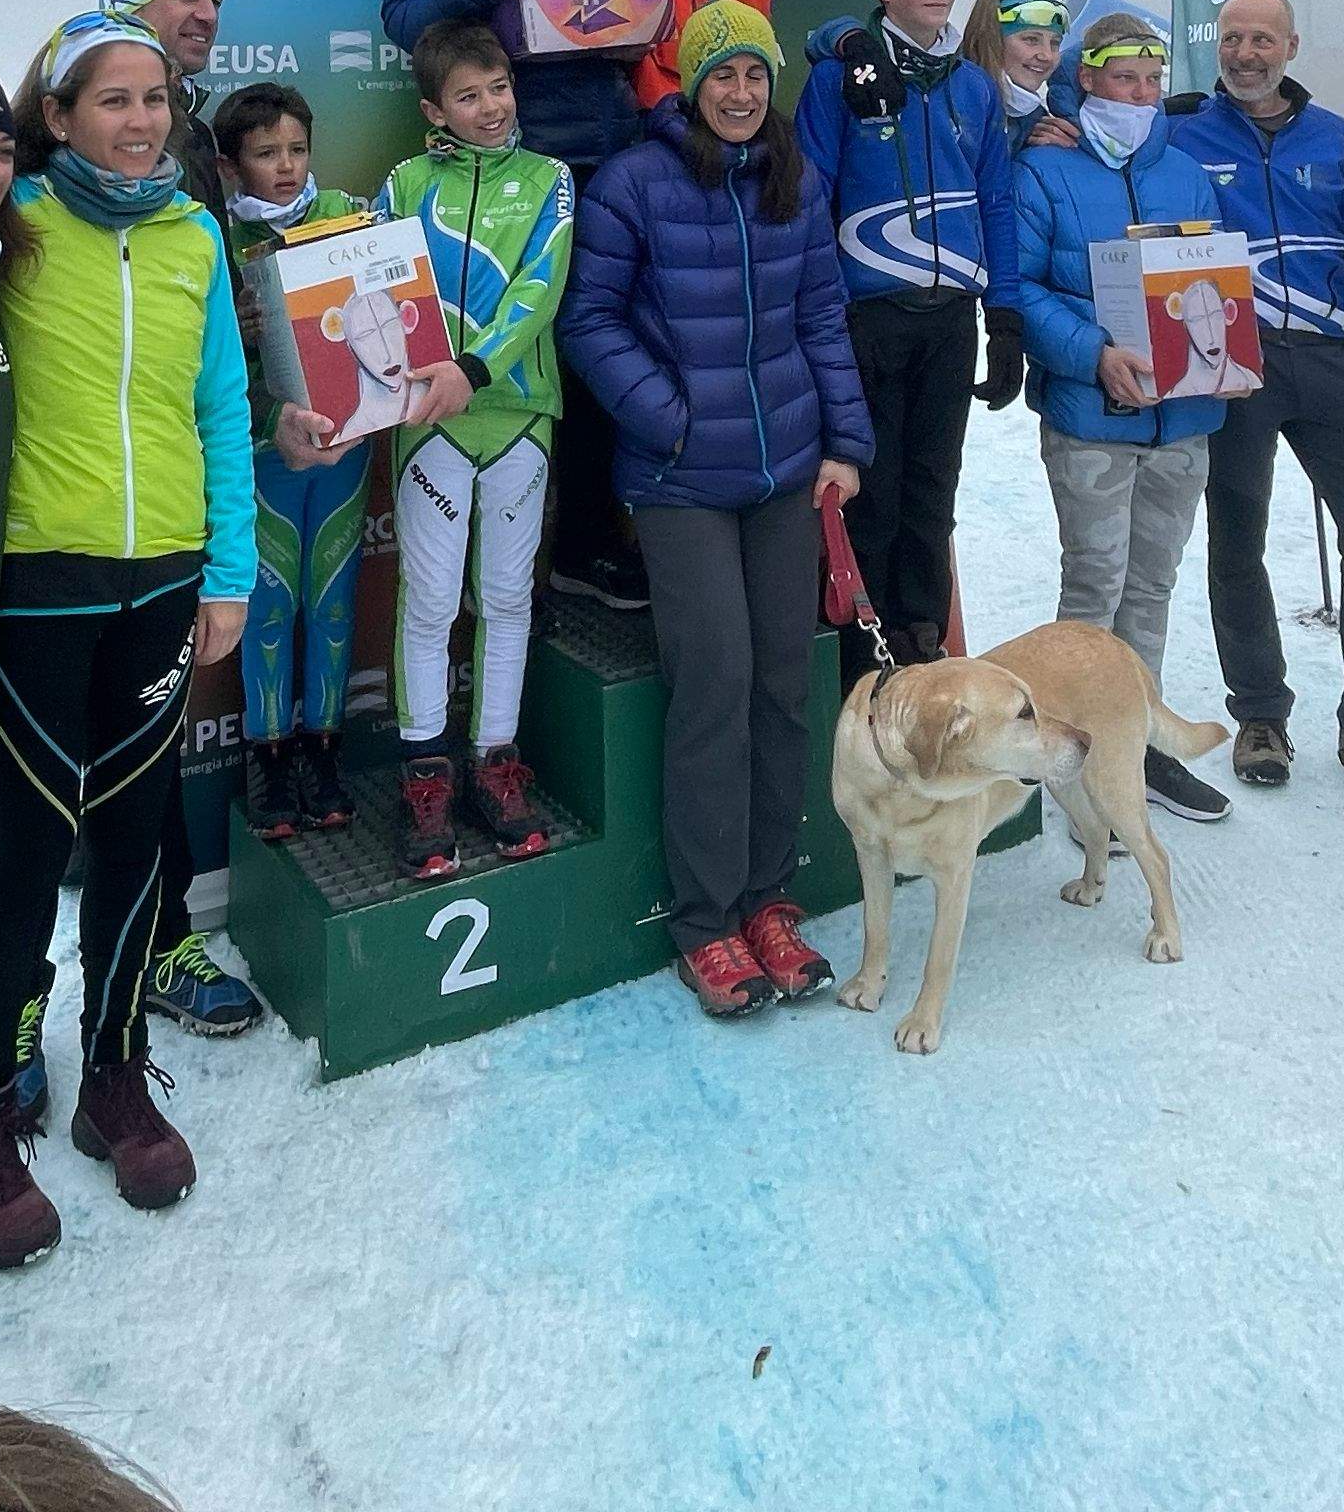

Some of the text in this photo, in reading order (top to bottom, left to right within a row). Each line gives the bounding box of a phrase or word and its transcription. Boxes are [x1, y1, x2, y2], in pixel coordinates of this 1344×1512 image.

[209, 44, 300, 75] EUSA
[180, 758, 222, 778] energia
[424, 897, 499, 996] 2
